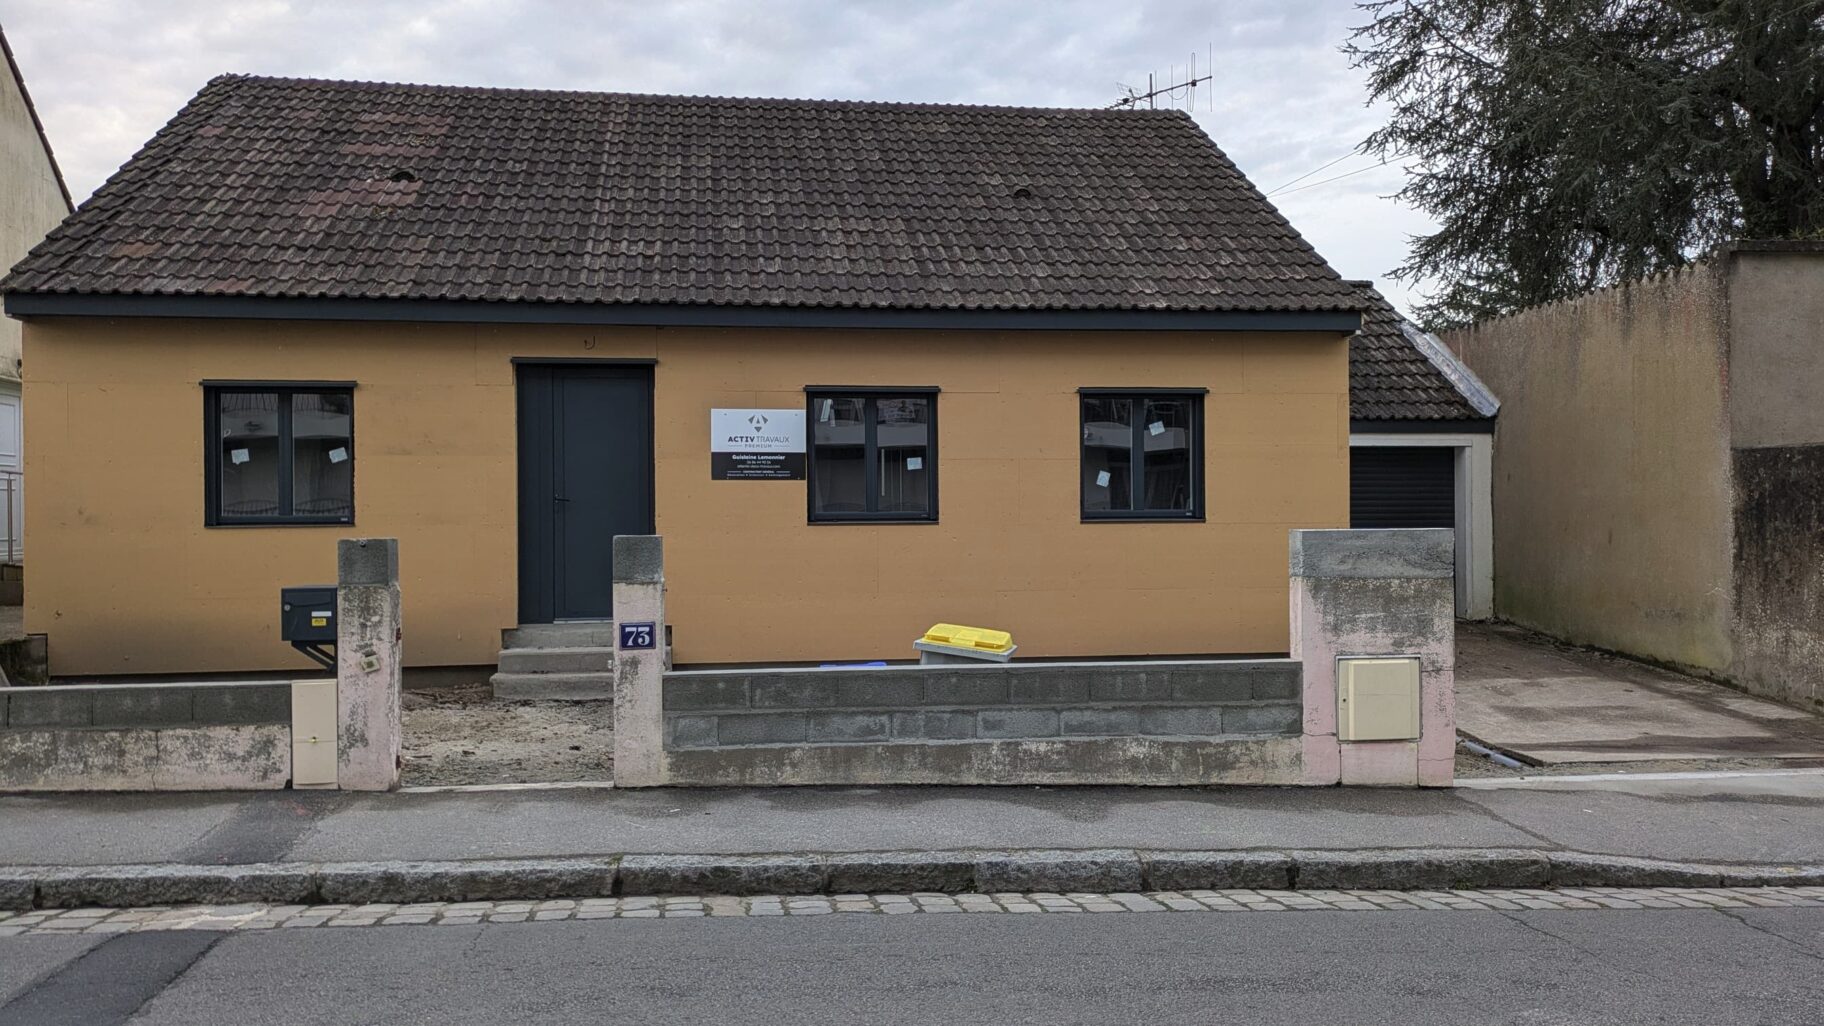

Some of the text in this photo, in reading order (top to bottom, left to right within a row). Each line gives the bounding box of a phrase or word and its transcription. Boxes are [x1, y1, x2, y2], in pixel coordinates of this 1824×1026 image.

[727, 435, 790, 443] ACTIV TRAVAUX
[625, 626, 650, 646] 73
